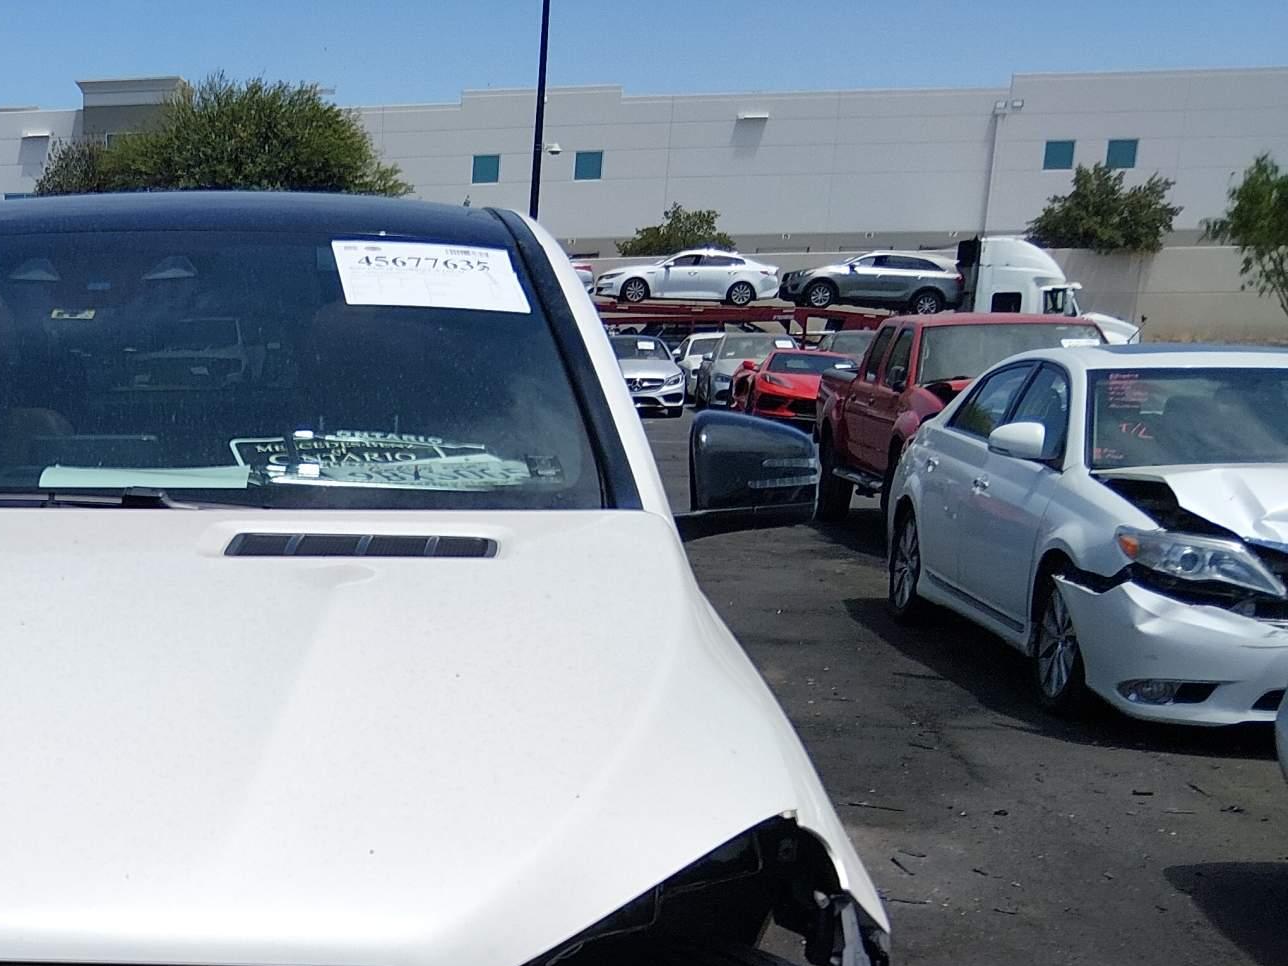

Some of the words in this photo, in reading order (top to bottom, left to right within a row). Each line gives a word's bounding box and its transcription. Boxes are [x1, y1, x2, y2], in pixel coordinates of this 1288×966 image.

[357, 254, 490, 272] 45677635
[336, 429, 443, 445] ONTARIO
[255, 439, 415, 453] MECEDES-BENZ
[268, 450, 417, 466] ONTARIO
